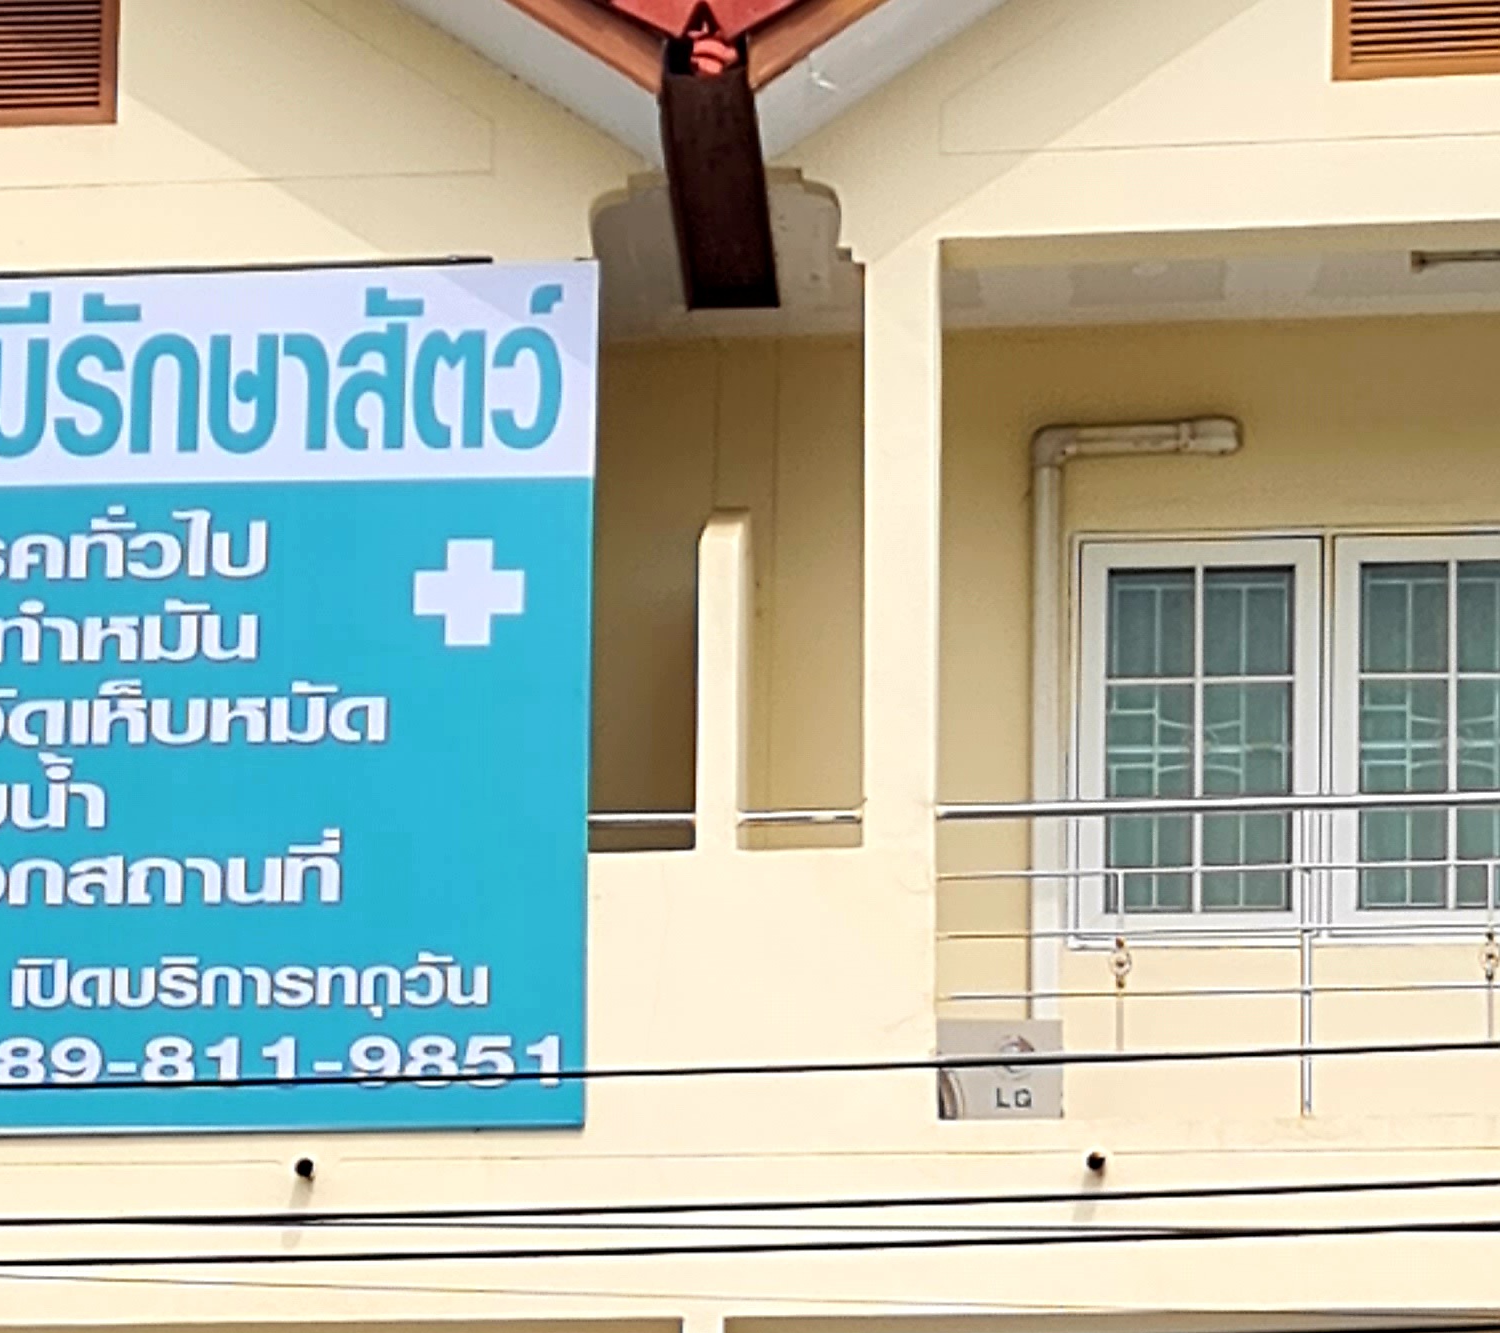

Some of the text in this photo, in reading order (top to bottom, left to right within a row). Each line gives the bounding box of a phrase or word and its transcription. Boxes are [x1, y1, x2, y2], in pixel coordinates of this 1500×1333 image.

[10, 950, 490, 1019] เปิดบริการทุกวัน
